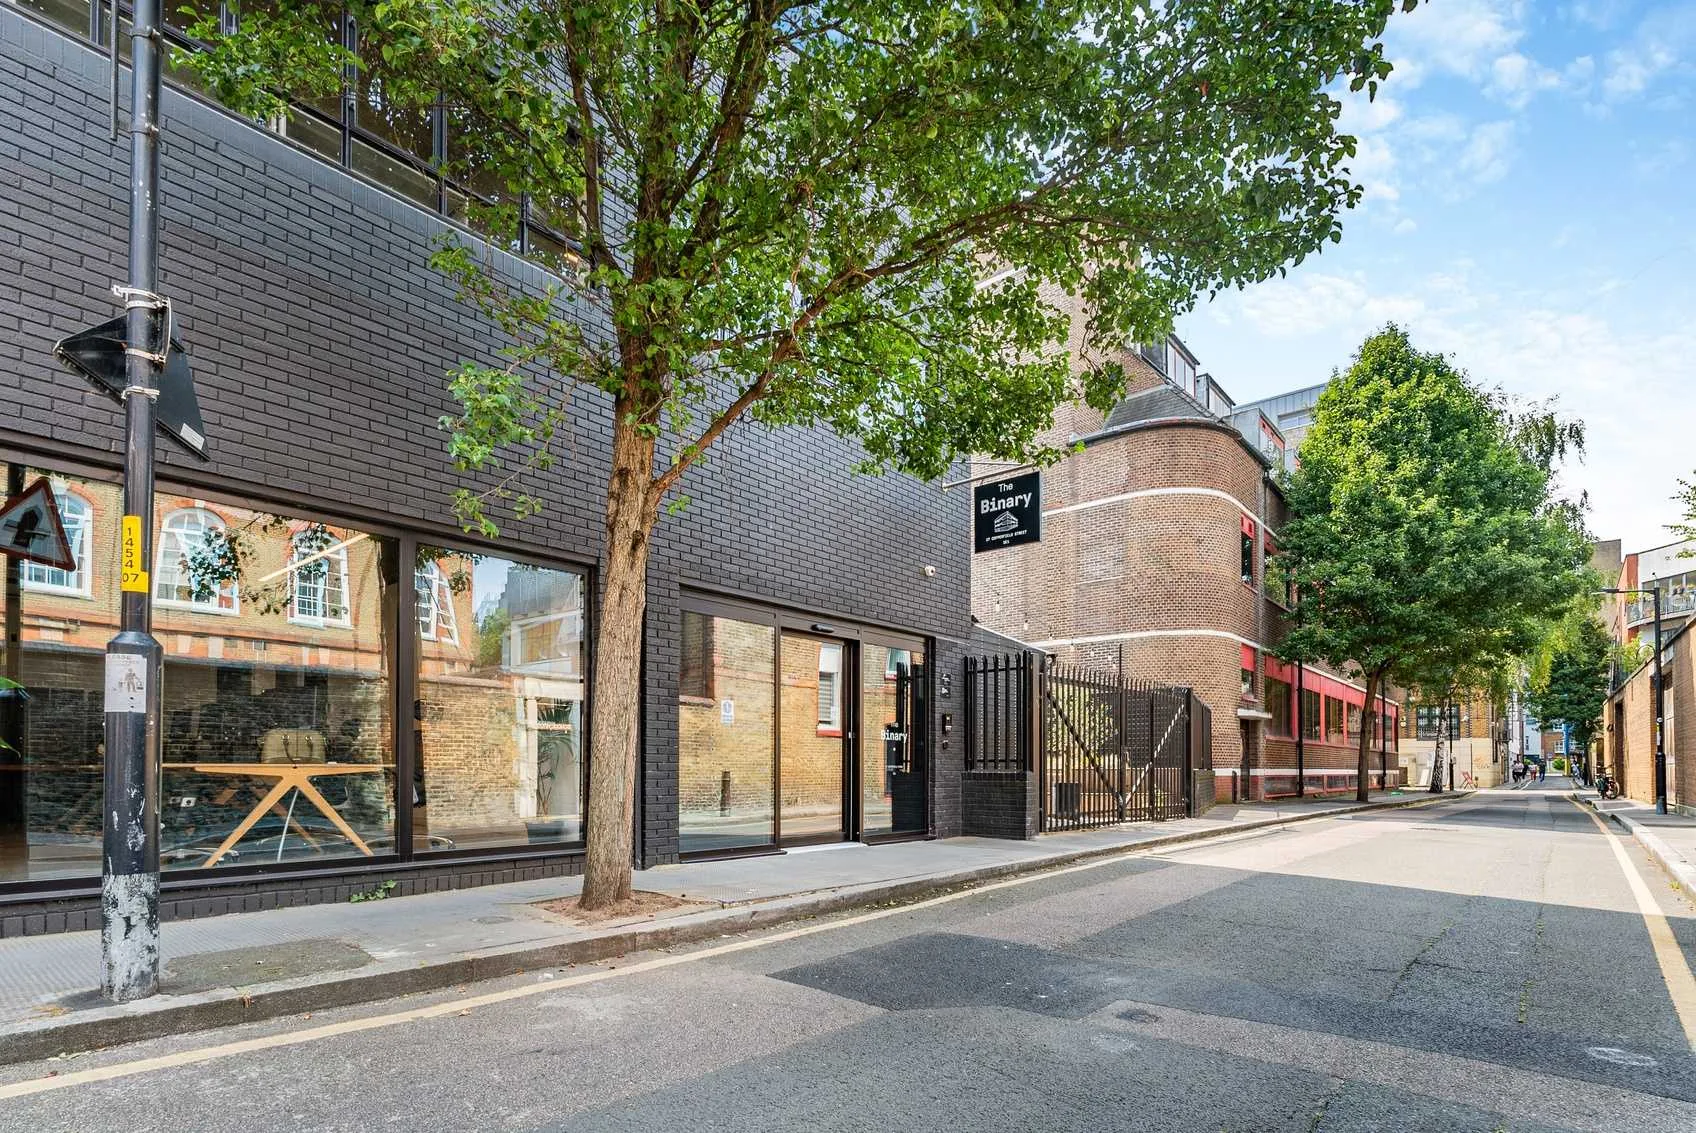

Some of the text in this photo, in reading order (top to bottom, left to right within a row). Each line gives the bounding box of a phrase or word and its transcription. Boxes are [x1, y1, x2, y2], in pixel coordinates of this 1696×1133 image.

[998, 483, 1014, 492] The
[980, 492, 1032, 514] Binary
[880, 729, 907, 744] Binary
